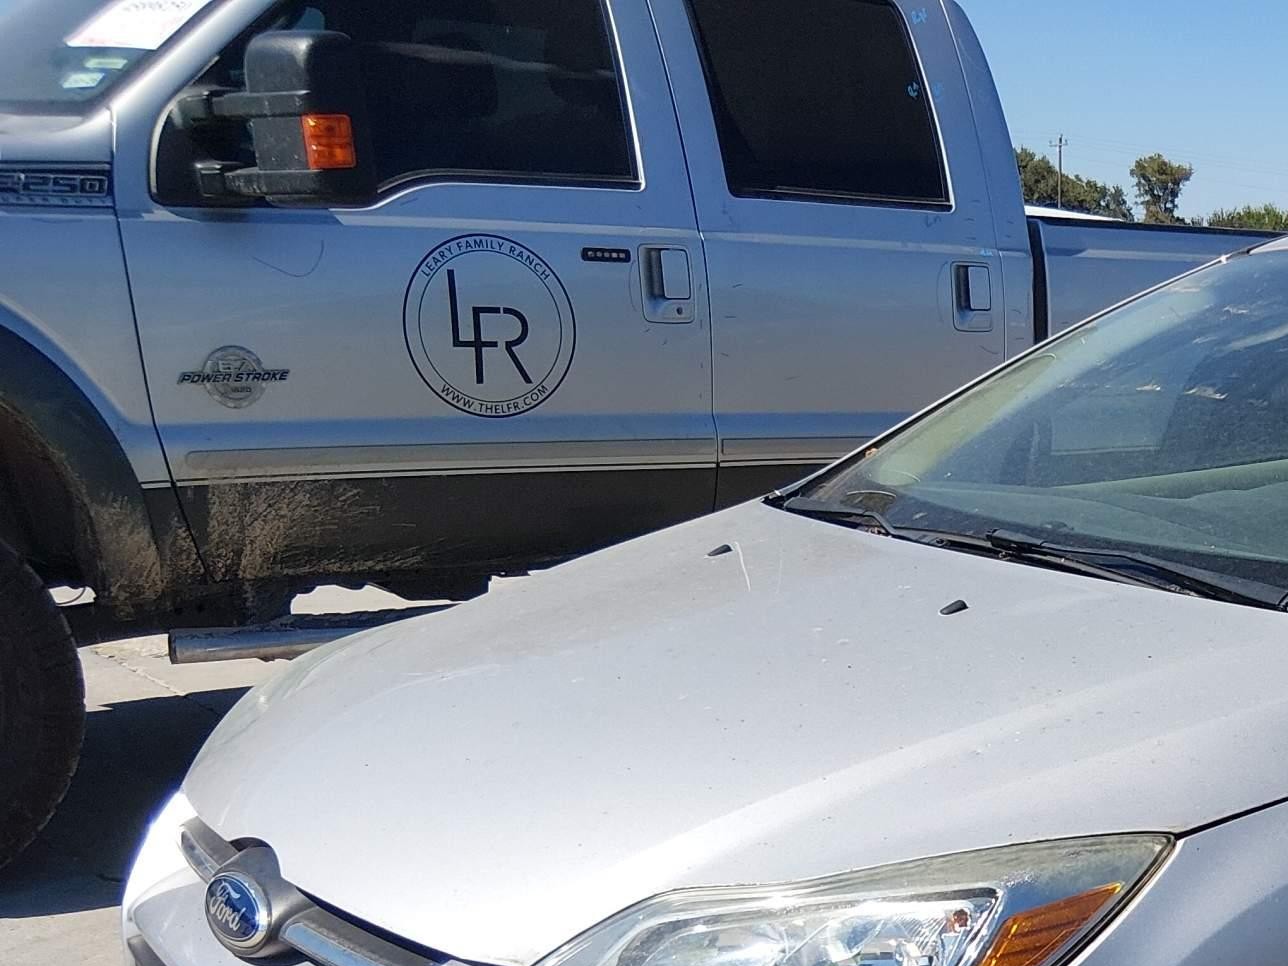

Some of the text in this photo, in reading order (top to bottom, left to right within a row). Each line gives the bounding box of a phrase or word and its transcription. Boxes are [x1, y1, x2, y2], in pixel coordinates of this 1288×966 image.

[421, 239, 550, 280] LEARY FAMILY RANCH
[180, 371, 289, 383] POWER STROKE
[441, 384, 549, 414] WWW.THELFR.COM
[210, 880, 247, 931] Ford
